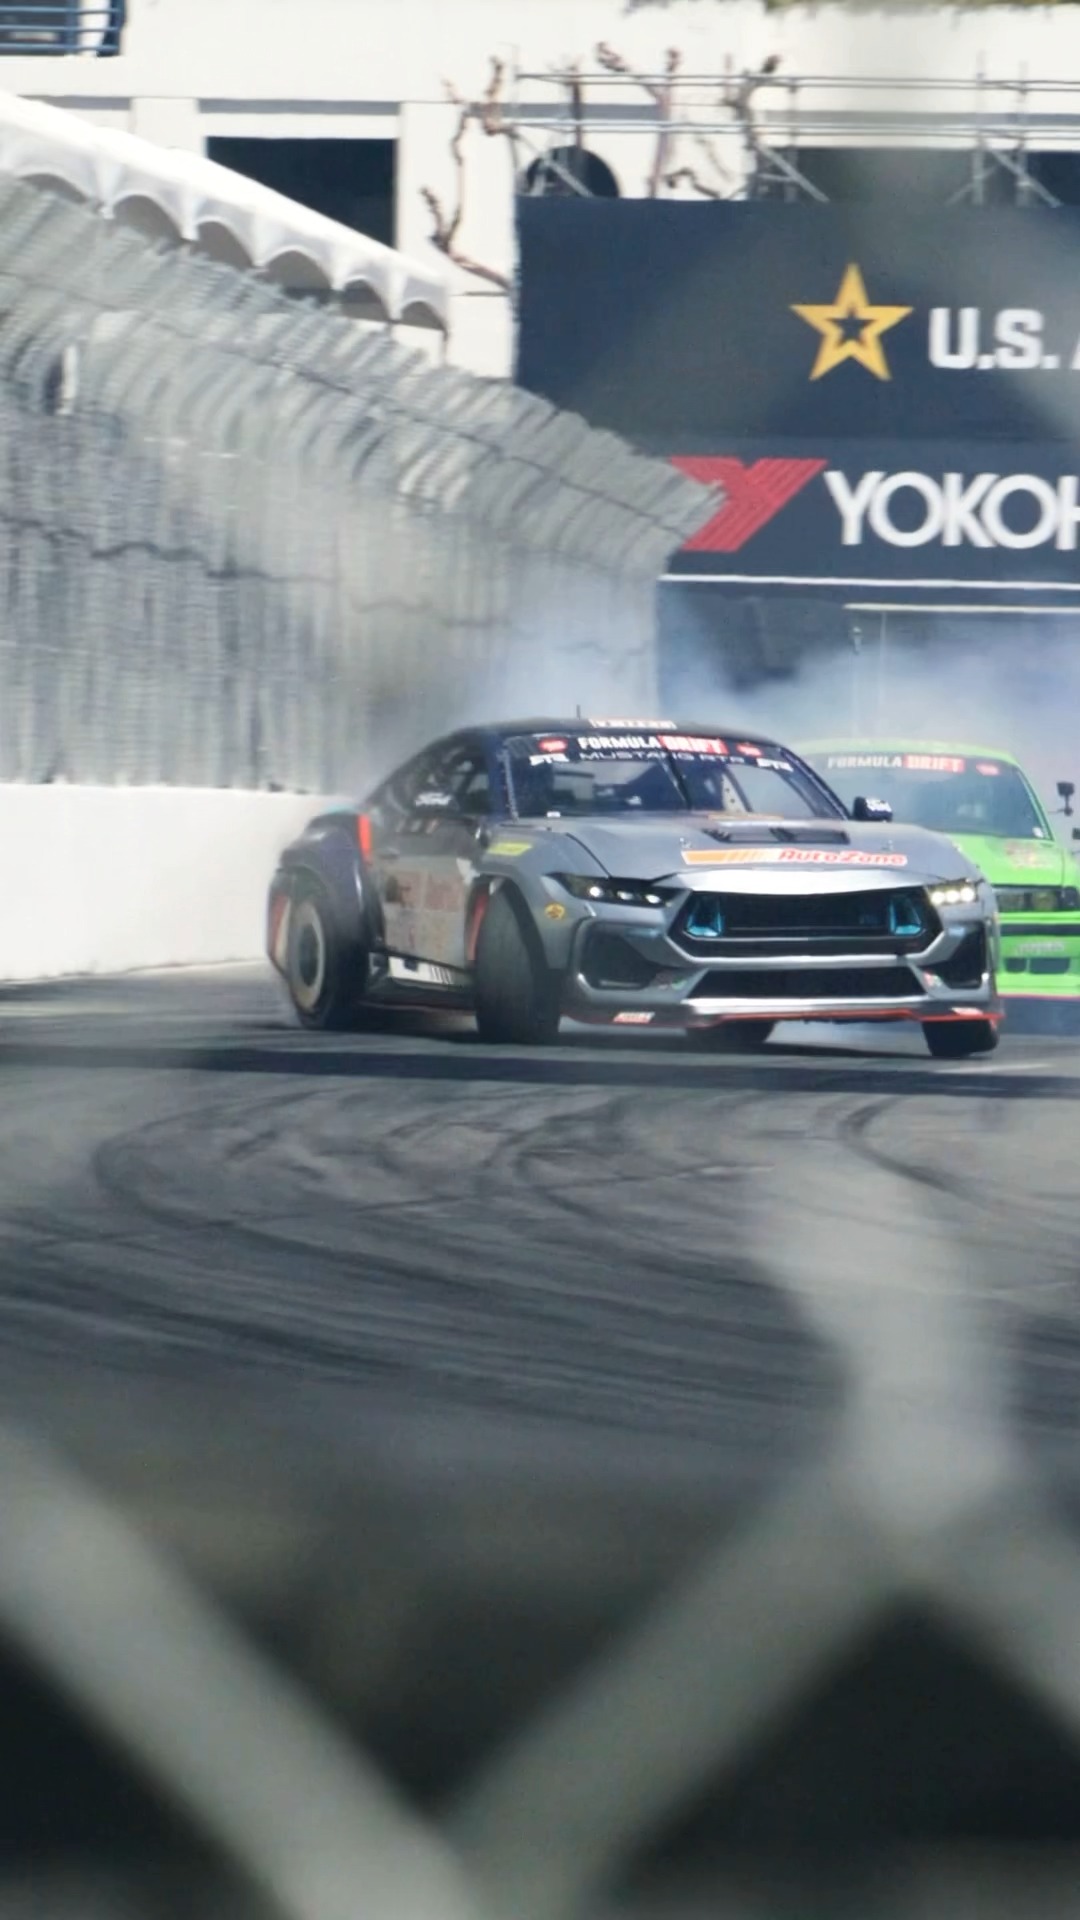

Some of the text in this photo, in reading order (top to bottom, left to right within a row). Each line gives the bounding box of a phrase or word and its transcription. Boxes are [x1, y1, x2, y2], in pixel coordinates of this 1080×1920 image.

[928, 306, 1060, 370] U.S.
[578, 736, 661, 750] FORMULA
[660, 735, 726, 754] DRIFT
[828, 755, 903, 769] FORMULA
[904, 754, 964, 773] DRIFT
[778, 847, 906, 865] AutoZone
